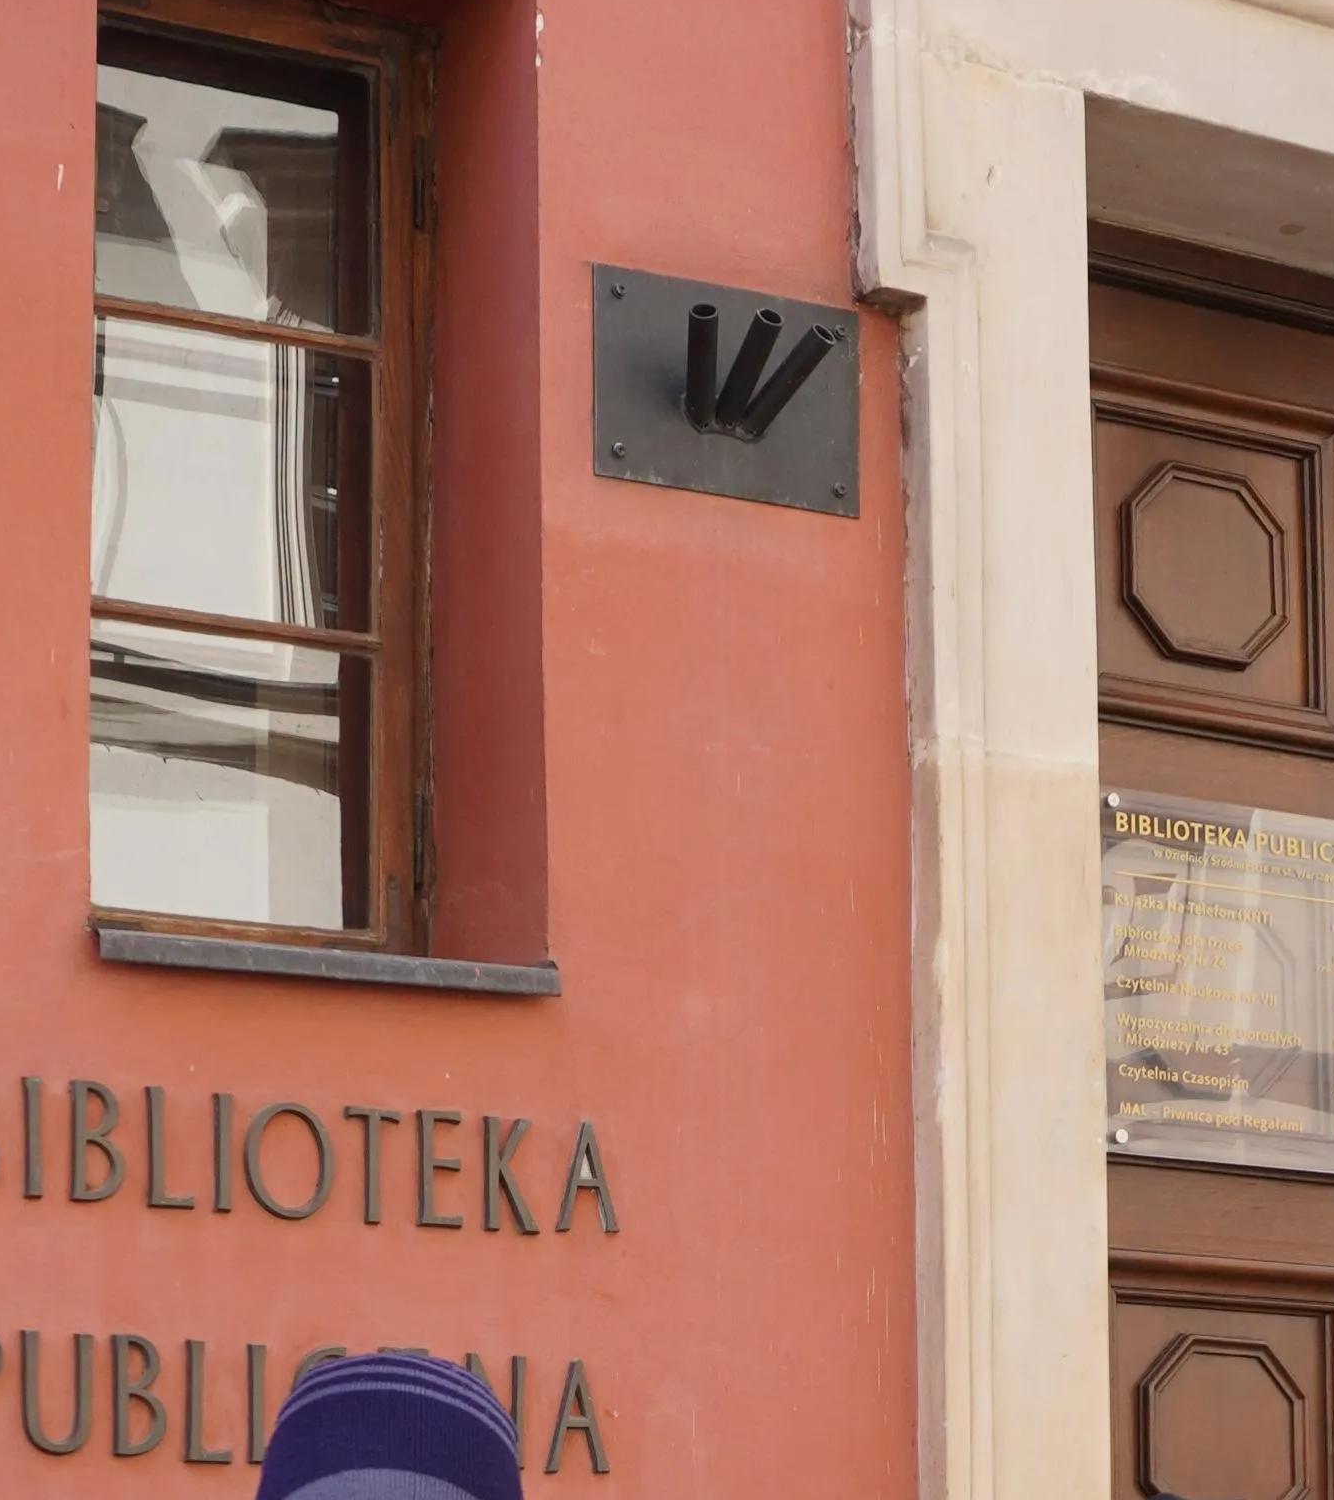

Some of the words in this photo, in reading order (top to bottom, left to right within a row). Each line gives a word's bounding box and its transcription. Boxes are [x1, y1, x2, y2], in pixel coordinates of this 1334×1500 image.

[1115, 811, 1247, 850] BIBLIOTEKA
[1116, 975, 1177, 994] Czytelnia
[1118, 1063, 1179, 1083] Czytelnia
[1182, 1070, 1250, 1091] Czasopism
[1119, 1102, 1147, 1116] MAL
[1163, 1105, 1213, 1123] Piwnica
[1216, 1111, 1240, 1128] pod
